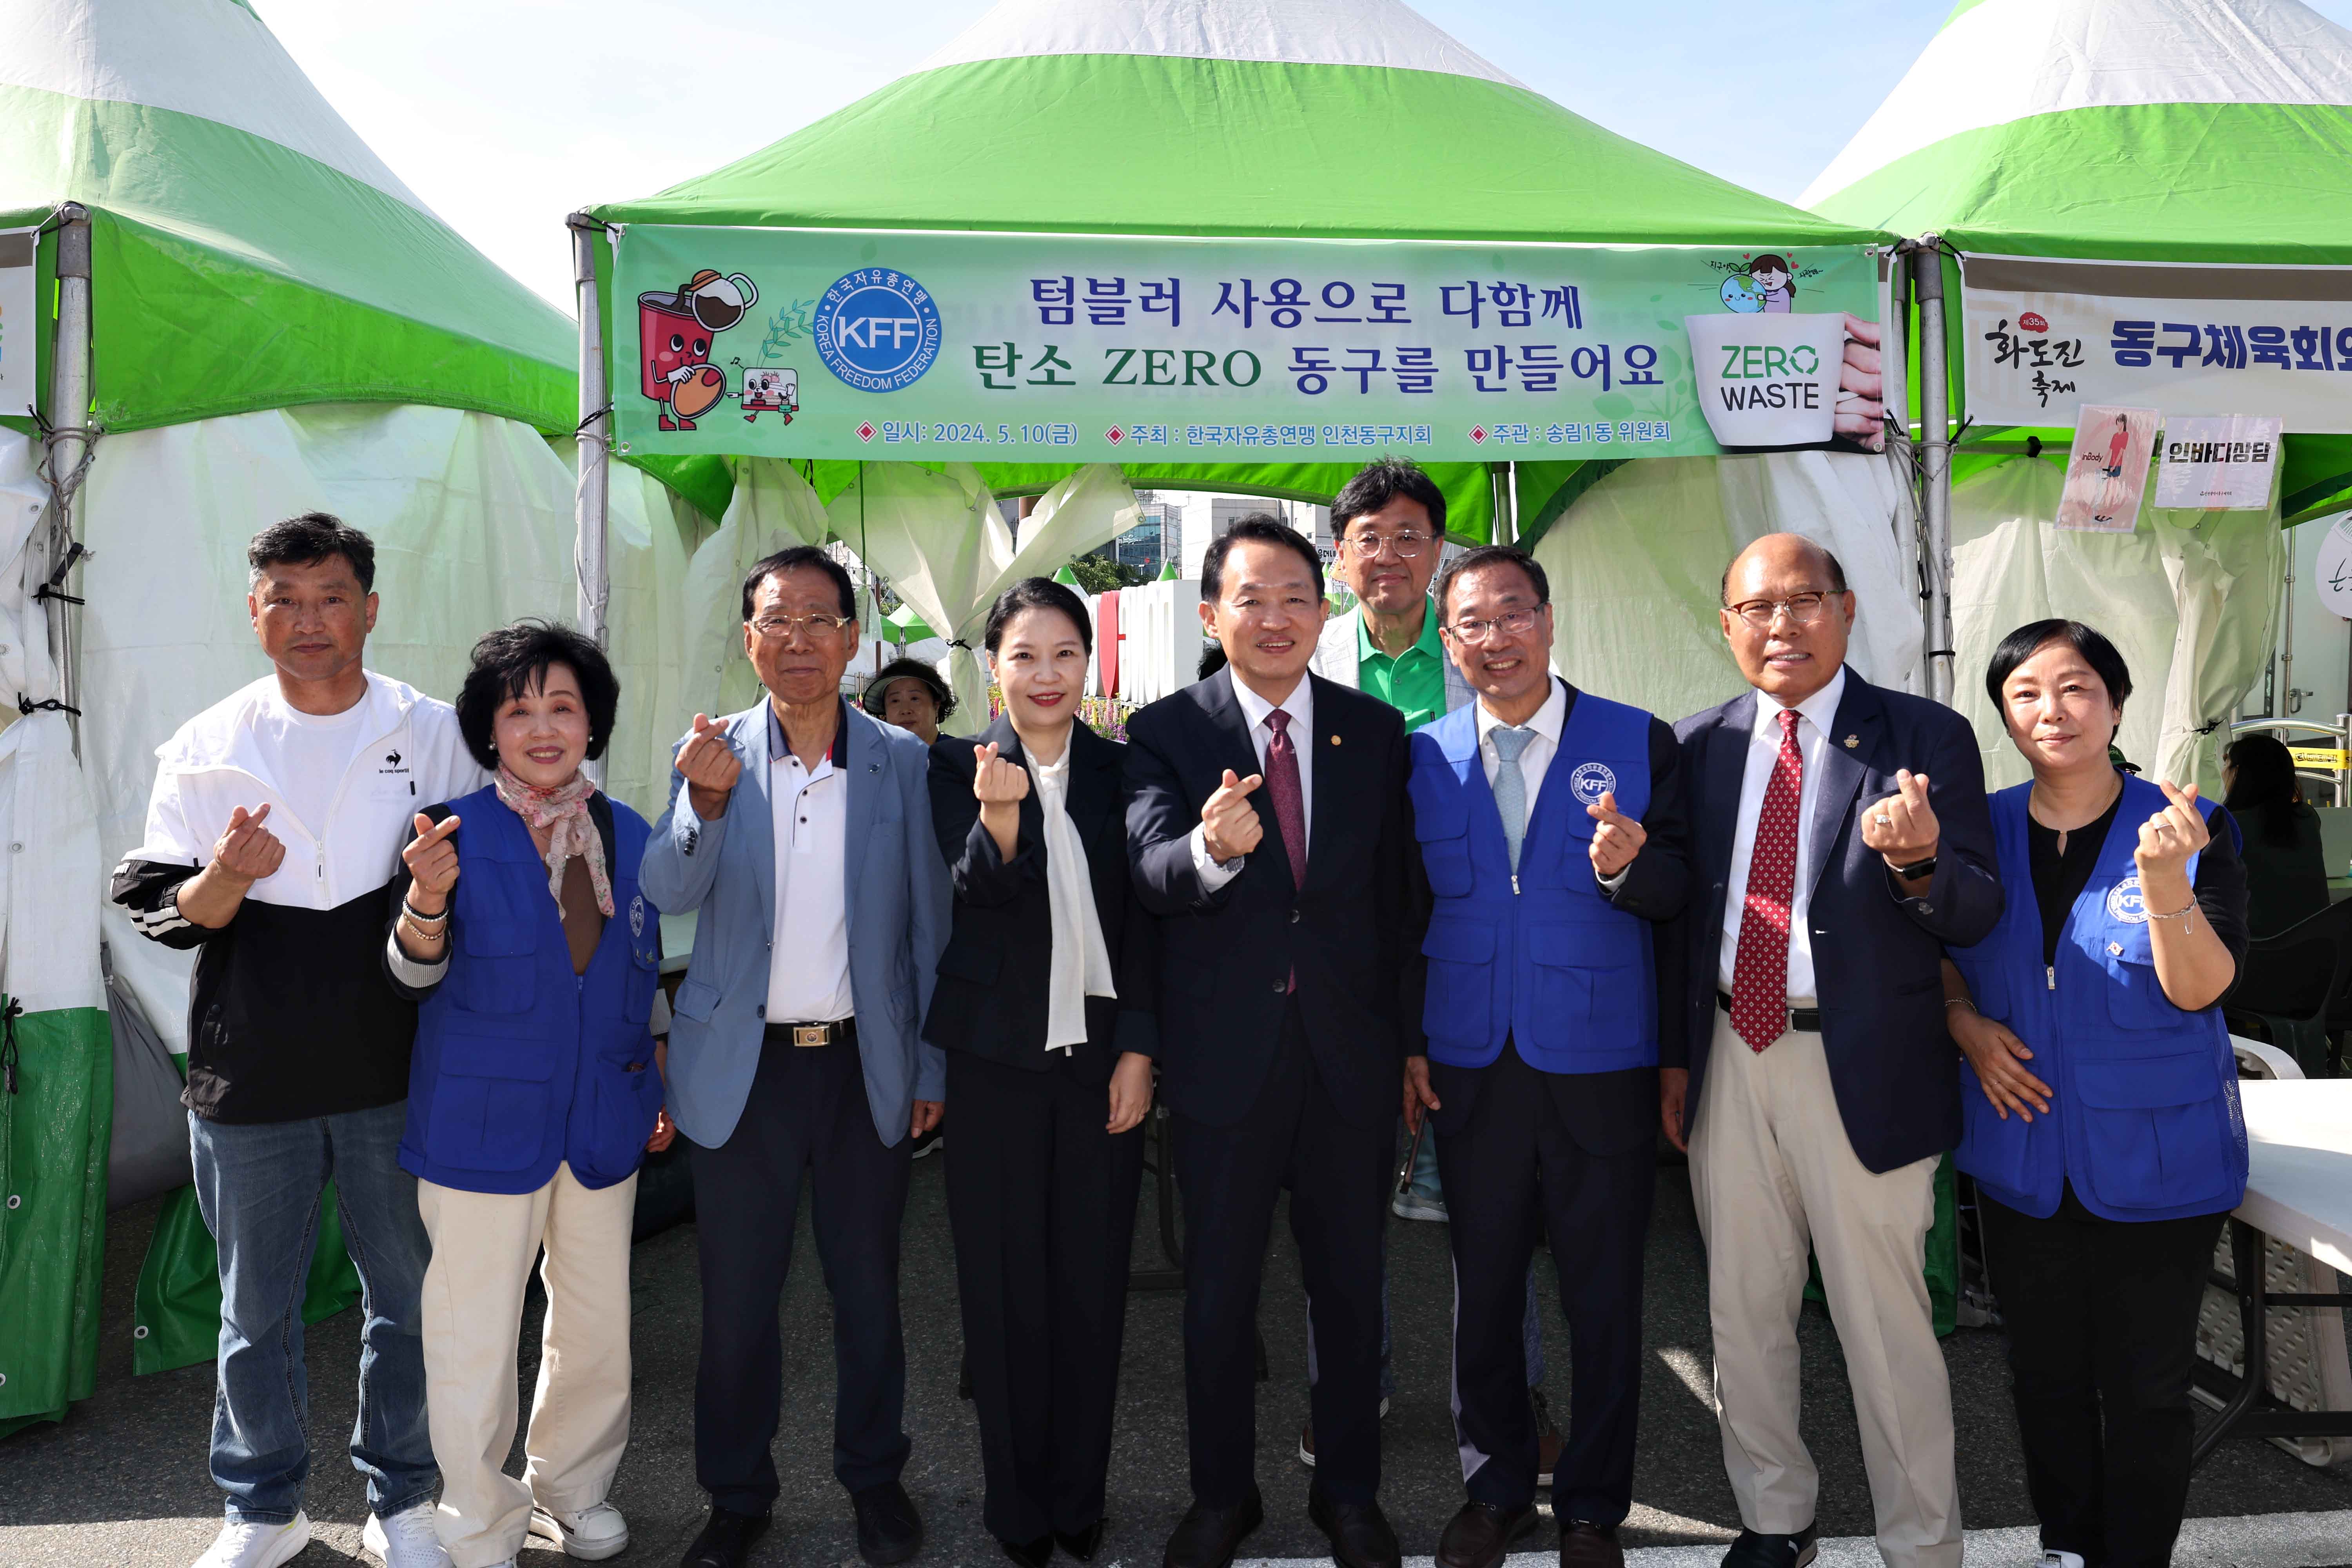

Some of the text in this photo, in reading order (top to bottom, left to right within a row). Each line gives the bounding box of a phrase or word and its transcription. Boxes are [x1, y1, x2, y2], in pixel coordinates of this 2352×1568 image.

[827, 269, 928, 305] 한국자유총연맹
[1030, 276, 1583, 329] 텀블러 사용으로 다함께
[837, 316, 917, 349] KFF
[2022, 317, 2045, 326] 제35회
[817, 315, 938, 389] KOREA FREEDOM FEDERATION
[1985, 319, 2085, 369] 화도진
[972, 341, 1664, 395] 탄소 ZERO 동구를 만들어요
[1720, 383, 1818, 411] WASTE
[2032, 370, 2076, 408] 축제
[882, 421, 927, 443] 일시:
[1130, 425, 1168, 445] 주최
[1186, 425, 1316, 446] 한국자유총연맹
[1322, 425, 1432, 446] 인천동구지회
[1493, 424, 1529, 444] 주관
[1546, 422, 1612, 443] 송림1동
[1618, 421, 1671, 442] 위원회
[2169, 442, 2271, 463] 인바디상담
[1580, 778, 1607, 791] KFF
